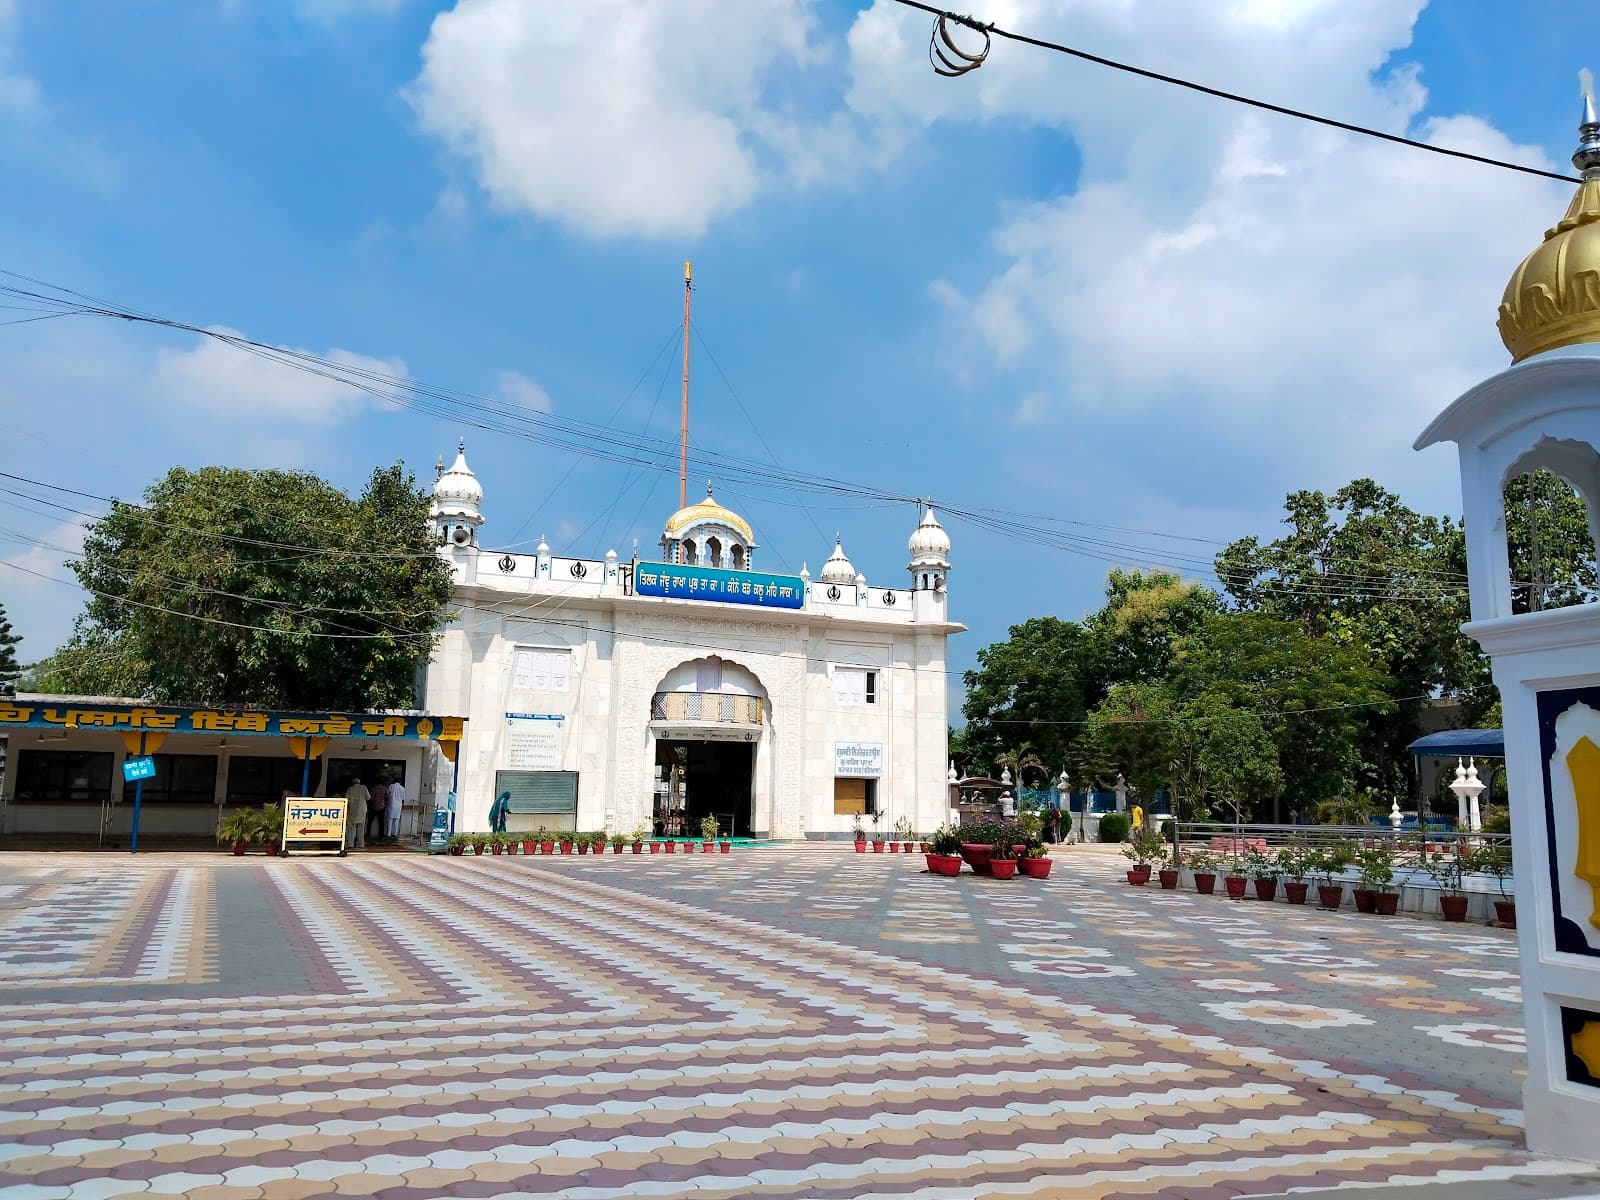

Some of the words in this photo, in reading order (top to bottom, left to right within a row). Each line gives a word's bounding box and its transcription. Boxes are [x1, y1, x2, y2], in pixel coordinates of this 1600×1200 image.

[640, 568, 657, 587] ਤਿਲਕ
[673, 575, 686, 589] ਰਾਖਾ
[689, 577, 698, 594] ਪ੍ਰਭ
[701, 578, 708, 591] ਤਾ
[710, 579, 718, 592] ਕਾ
[766, 581, 777, 598] ਮਹਿ
[780, 586, 793, 599] ਸਾਕਾ
[361, 716, 408, 736] ਜੀ
[290, 805, 319, 819] ਜੋੜਾ
[320, 808, 341, 819] ਘਰ
